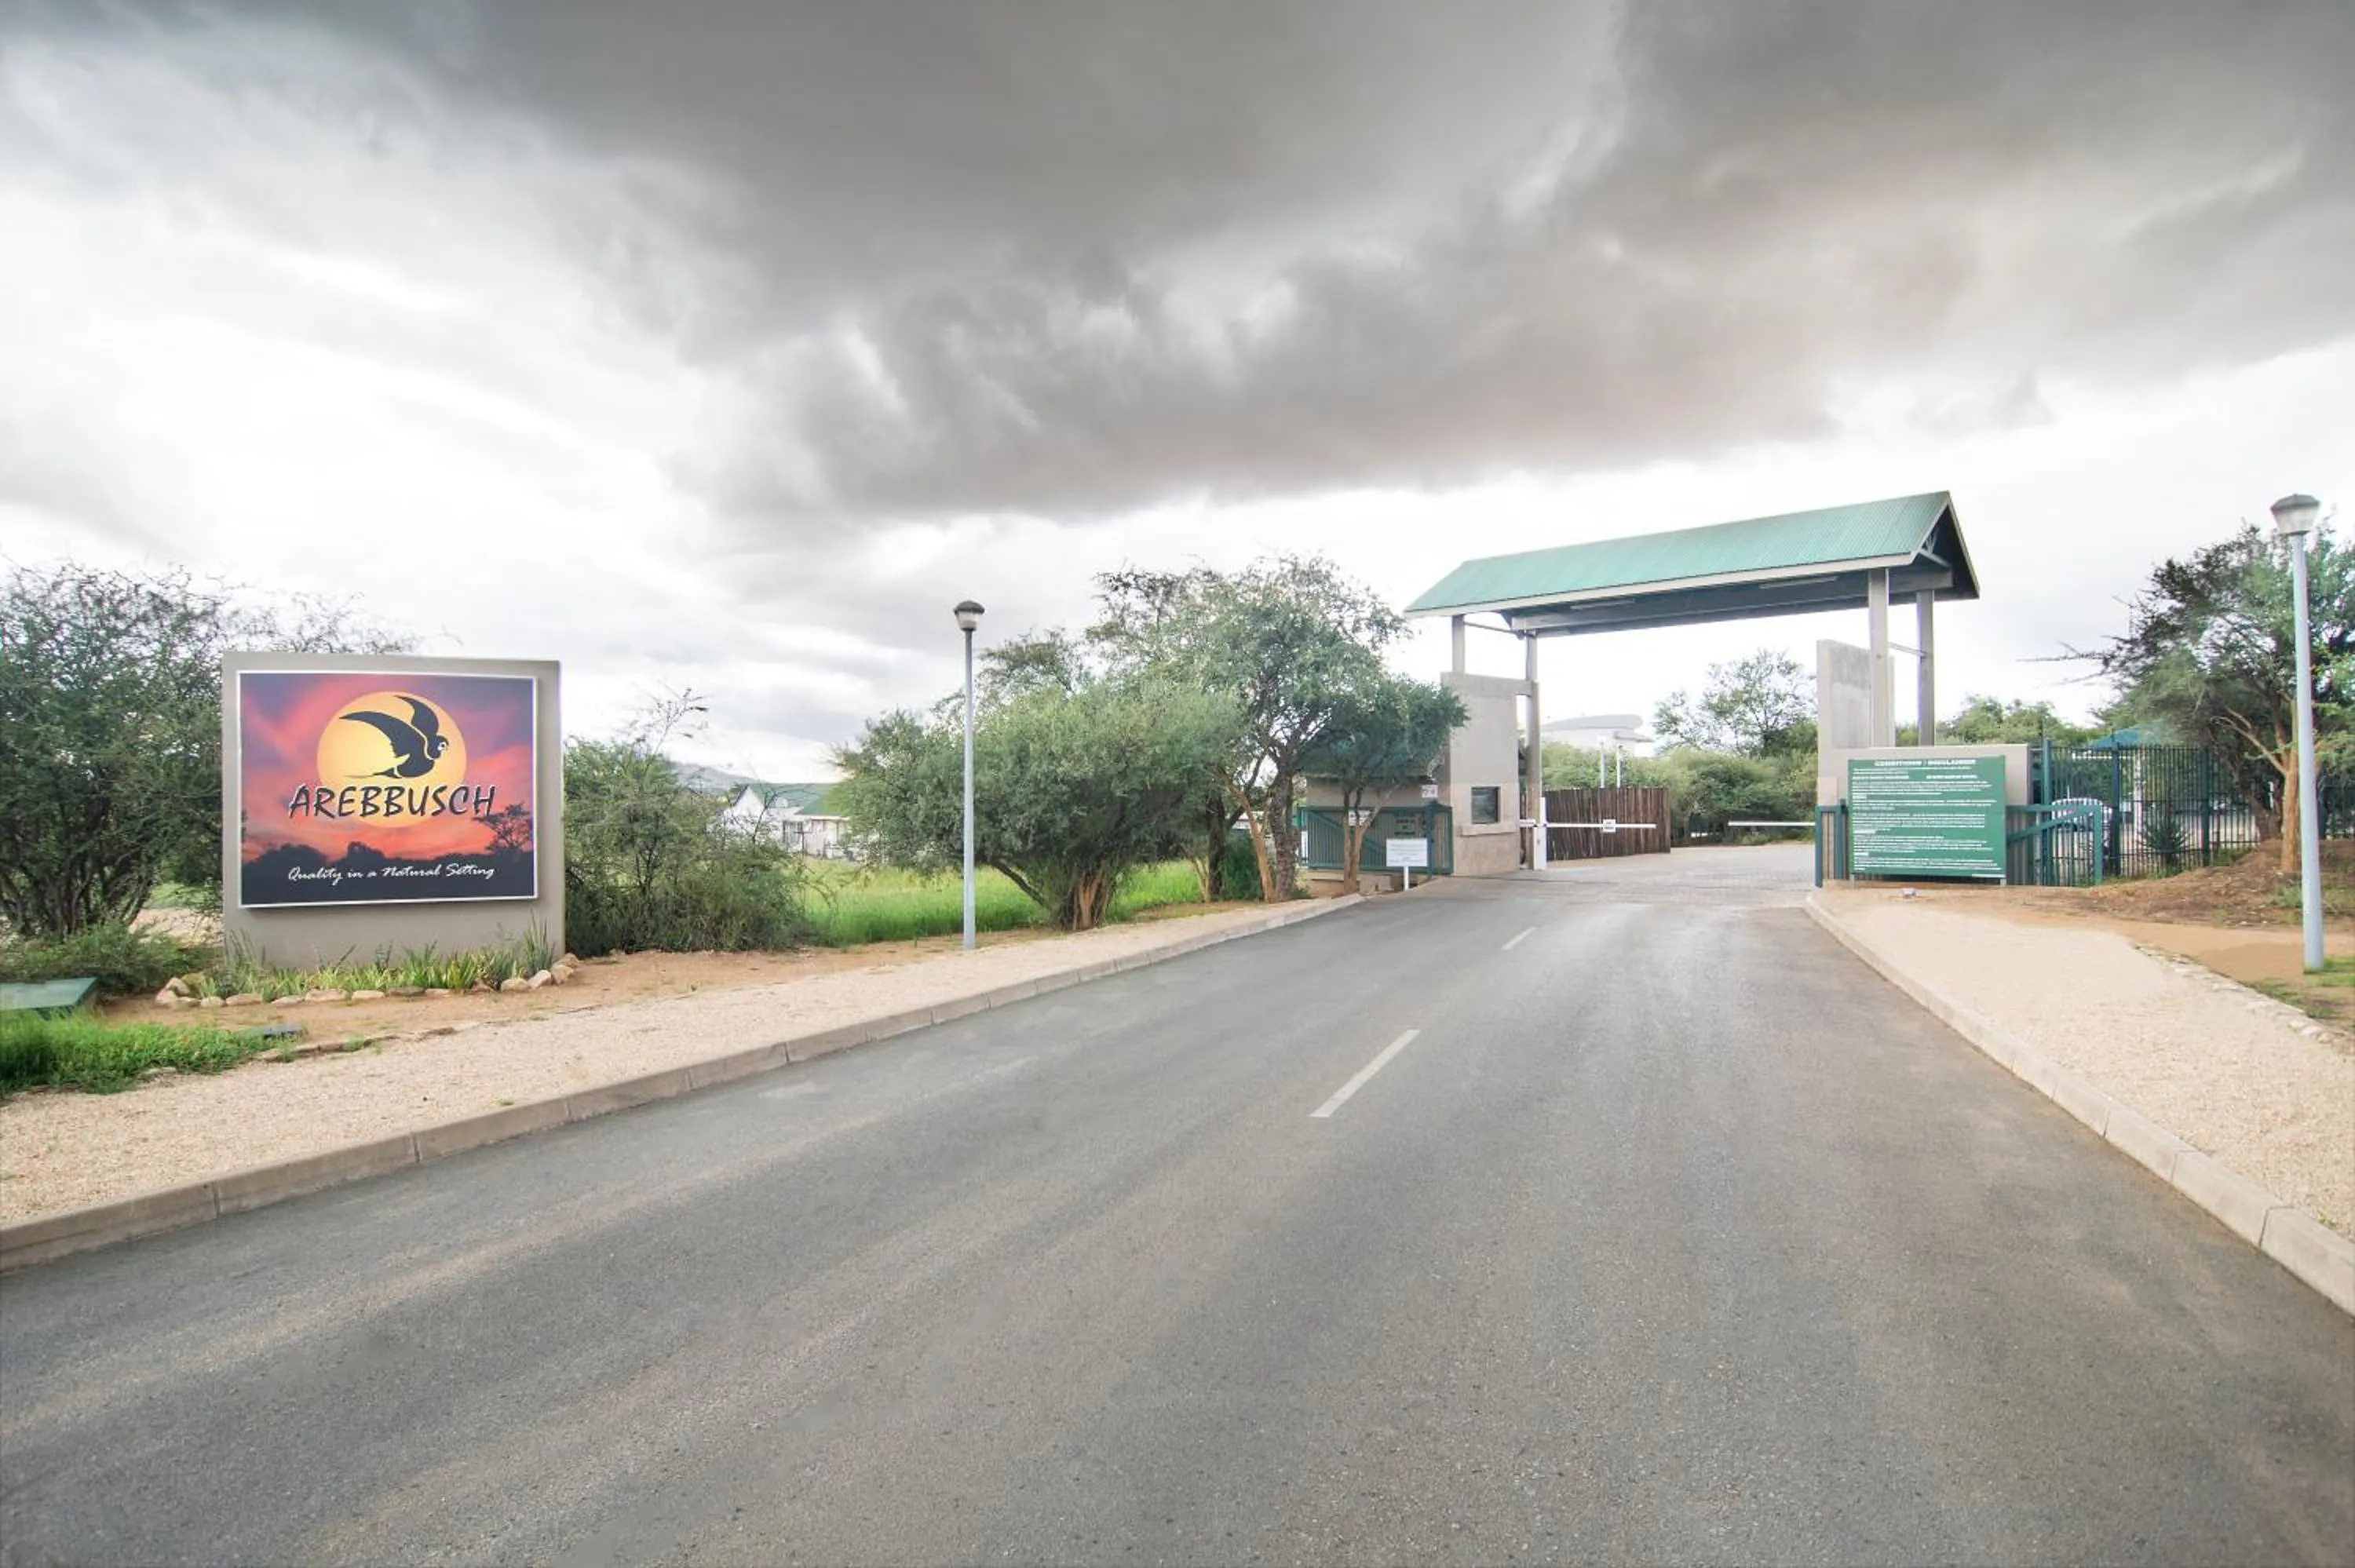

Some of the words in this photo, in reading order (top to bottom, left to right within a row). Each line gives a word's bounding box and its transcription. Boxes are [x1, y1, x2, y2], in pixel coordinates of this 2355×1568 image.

[289, 783, 496, 819] AREBBUSCH
[288, 866, 343, 886] Quality
[348, 869, 363, 878] in
[381, 864, 442, 877] Natural
[445, 862, 495, 880] Setting
